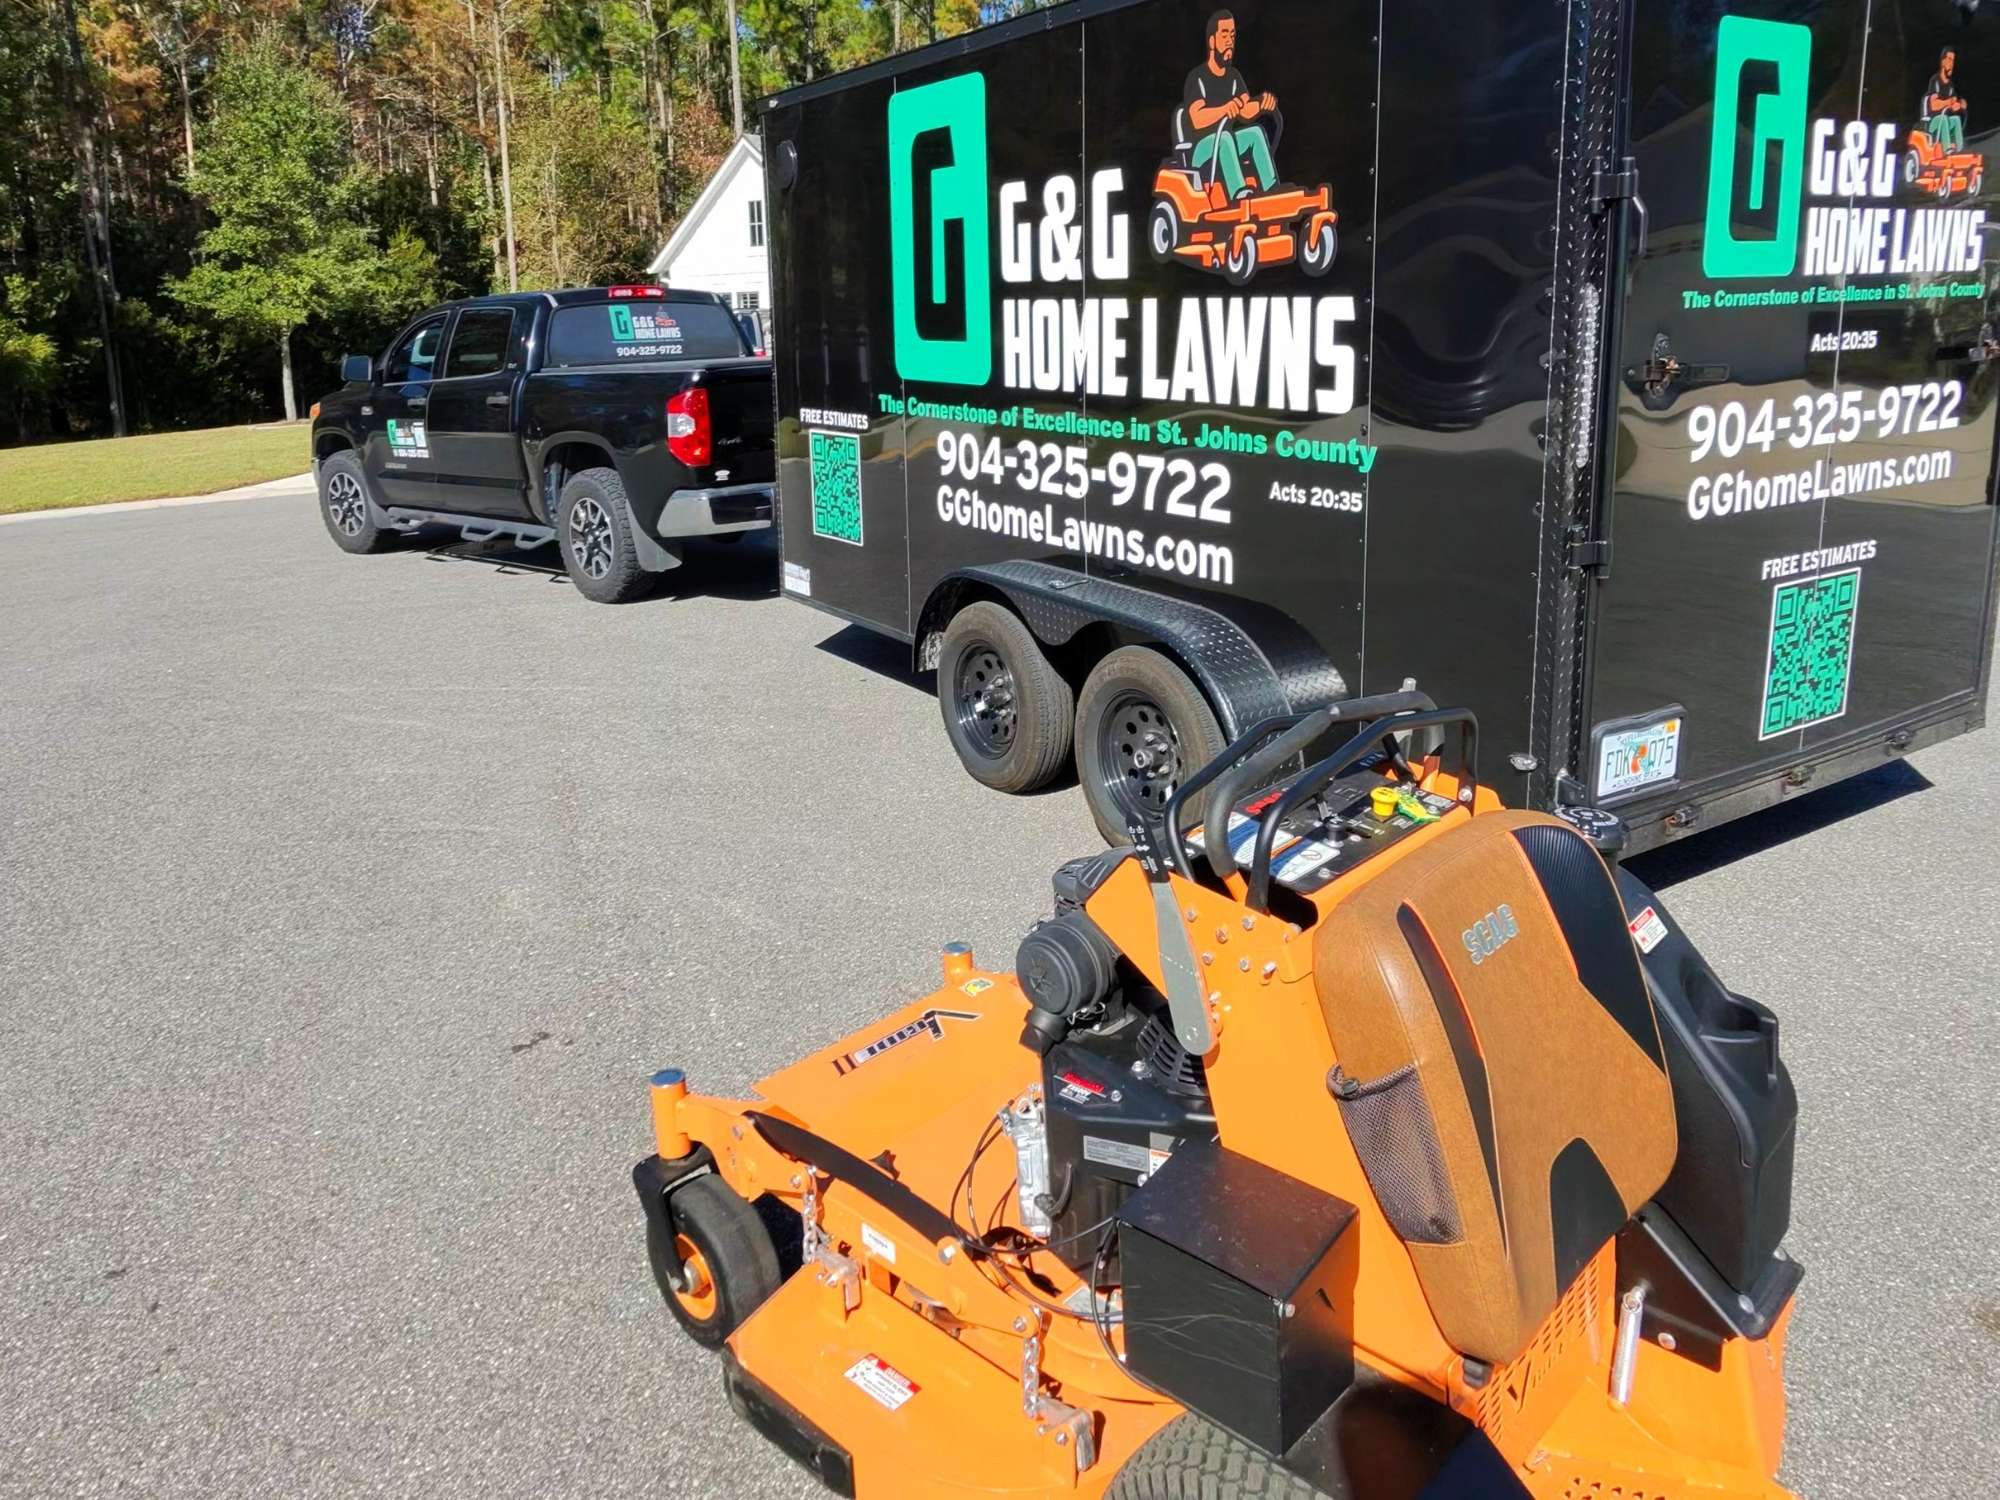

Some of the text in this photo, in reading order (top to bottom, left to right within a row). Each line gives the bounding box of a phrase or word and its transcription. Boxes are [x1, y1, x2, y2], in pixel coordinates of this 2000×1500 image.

[1809, 118, 1897, 198] G&G
[1000, 167, 1130, 283] G&G
[1804, 207, 1987, 277] HOME LAWNS
[1682, 281, 1986, 309] The Cornerstone of Excellence in St. Johns County
[616, 344, 683, 357] 904-325-9722
[1002, 296, 1356, 414] HOME LAWNS
[1810, 330, 1878, 352] Acts 20:35
[800, 407, 869, 430] FREE ESTIMATES
[878, 394, 1378, 474] The Cornerstone of Excellence in St. Johns County
[1687, 380, 1963, 463] 904-325-9722
[937, 430, 1232, 524] 904-325-9722
[1269, 481, 1363, 513] Acts 20:35
[1686, 449, 1952, 521] GGhomeLawns.com
[937, 485, 1234, 585] GGhomeLawns.com
[1761, 539, 1877, 580] FREE ESTIMATES
